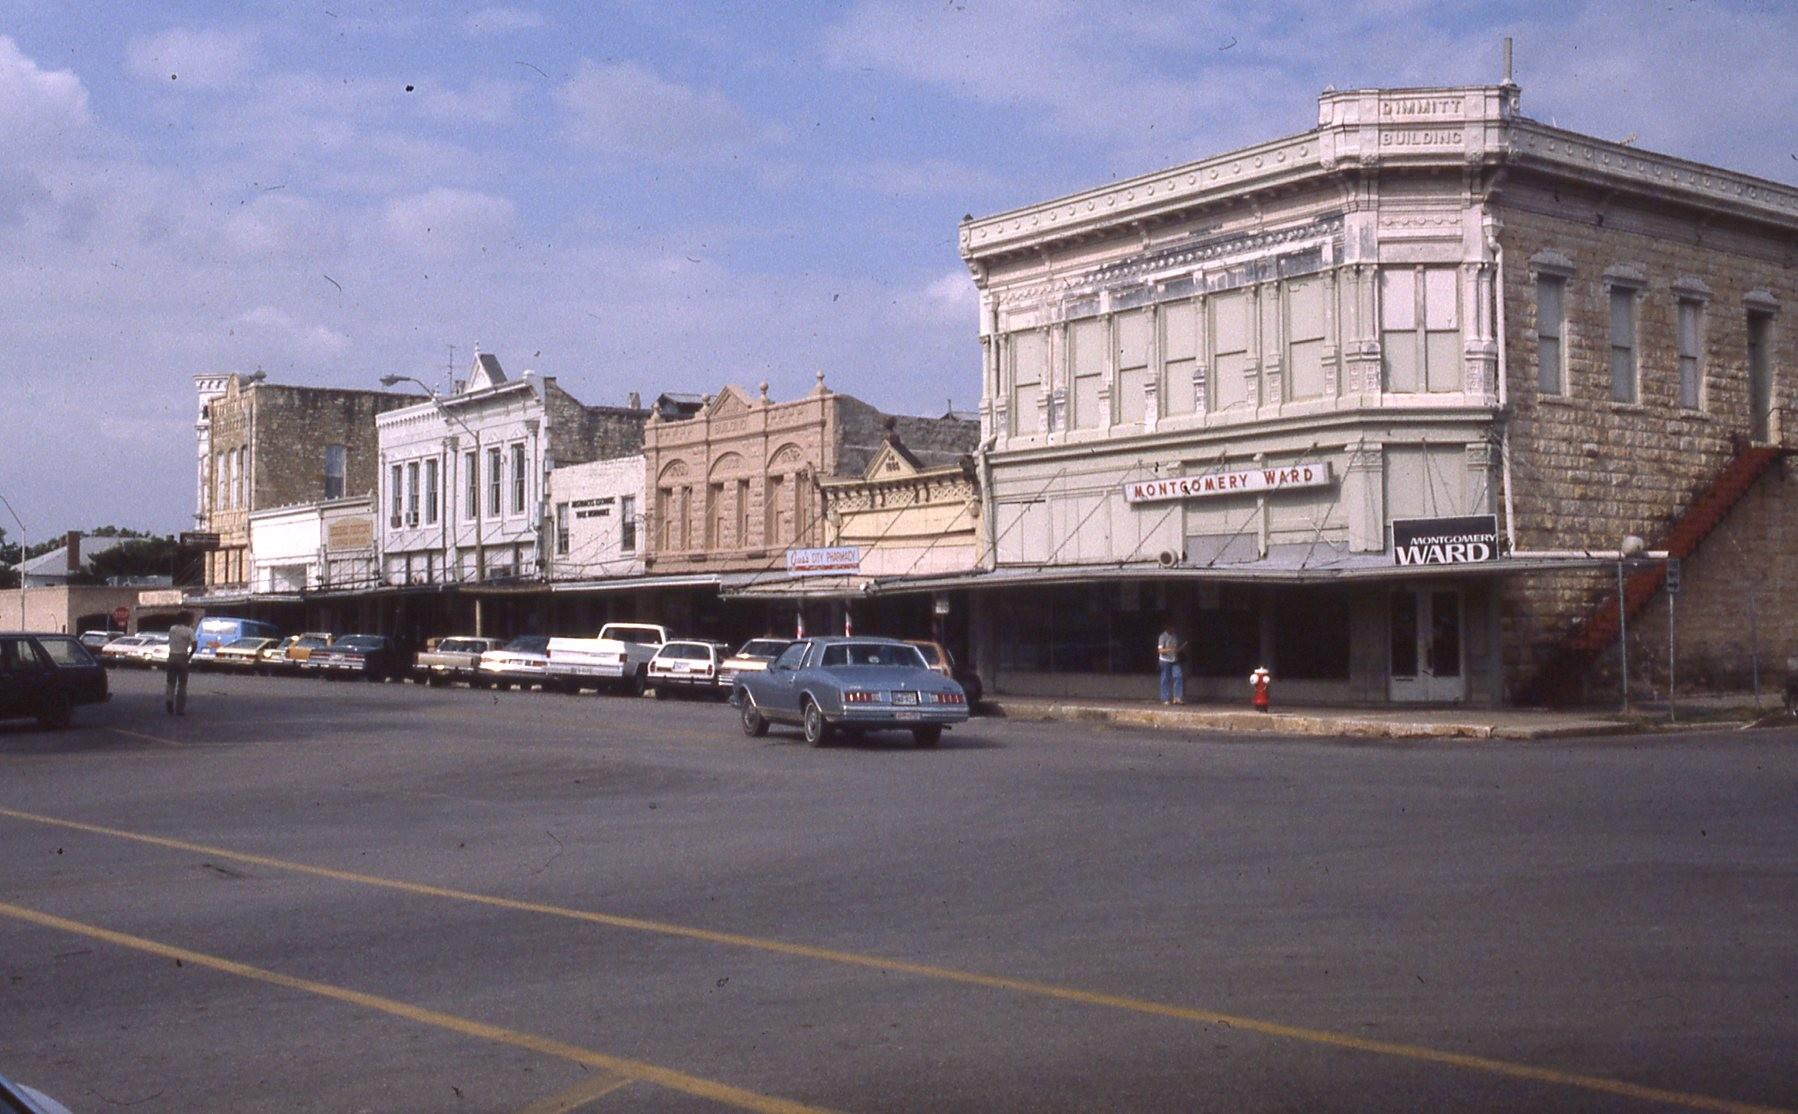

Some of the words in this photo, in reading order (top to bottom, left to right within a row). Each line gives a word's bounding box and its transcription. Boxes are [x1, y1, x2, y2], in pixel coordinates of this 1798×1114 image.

[1382, 100, 1462, 115] DIMMITT
[1382, 132, 1462, 146] BUILDING
[1134, 473, 1248, 498] MONTGOMERY
[1263, 468, 1314, 485] WARD
[1410, 533, 1497, 545] MONTGOMERY
[1395, 542, 1490, 566] WARD
